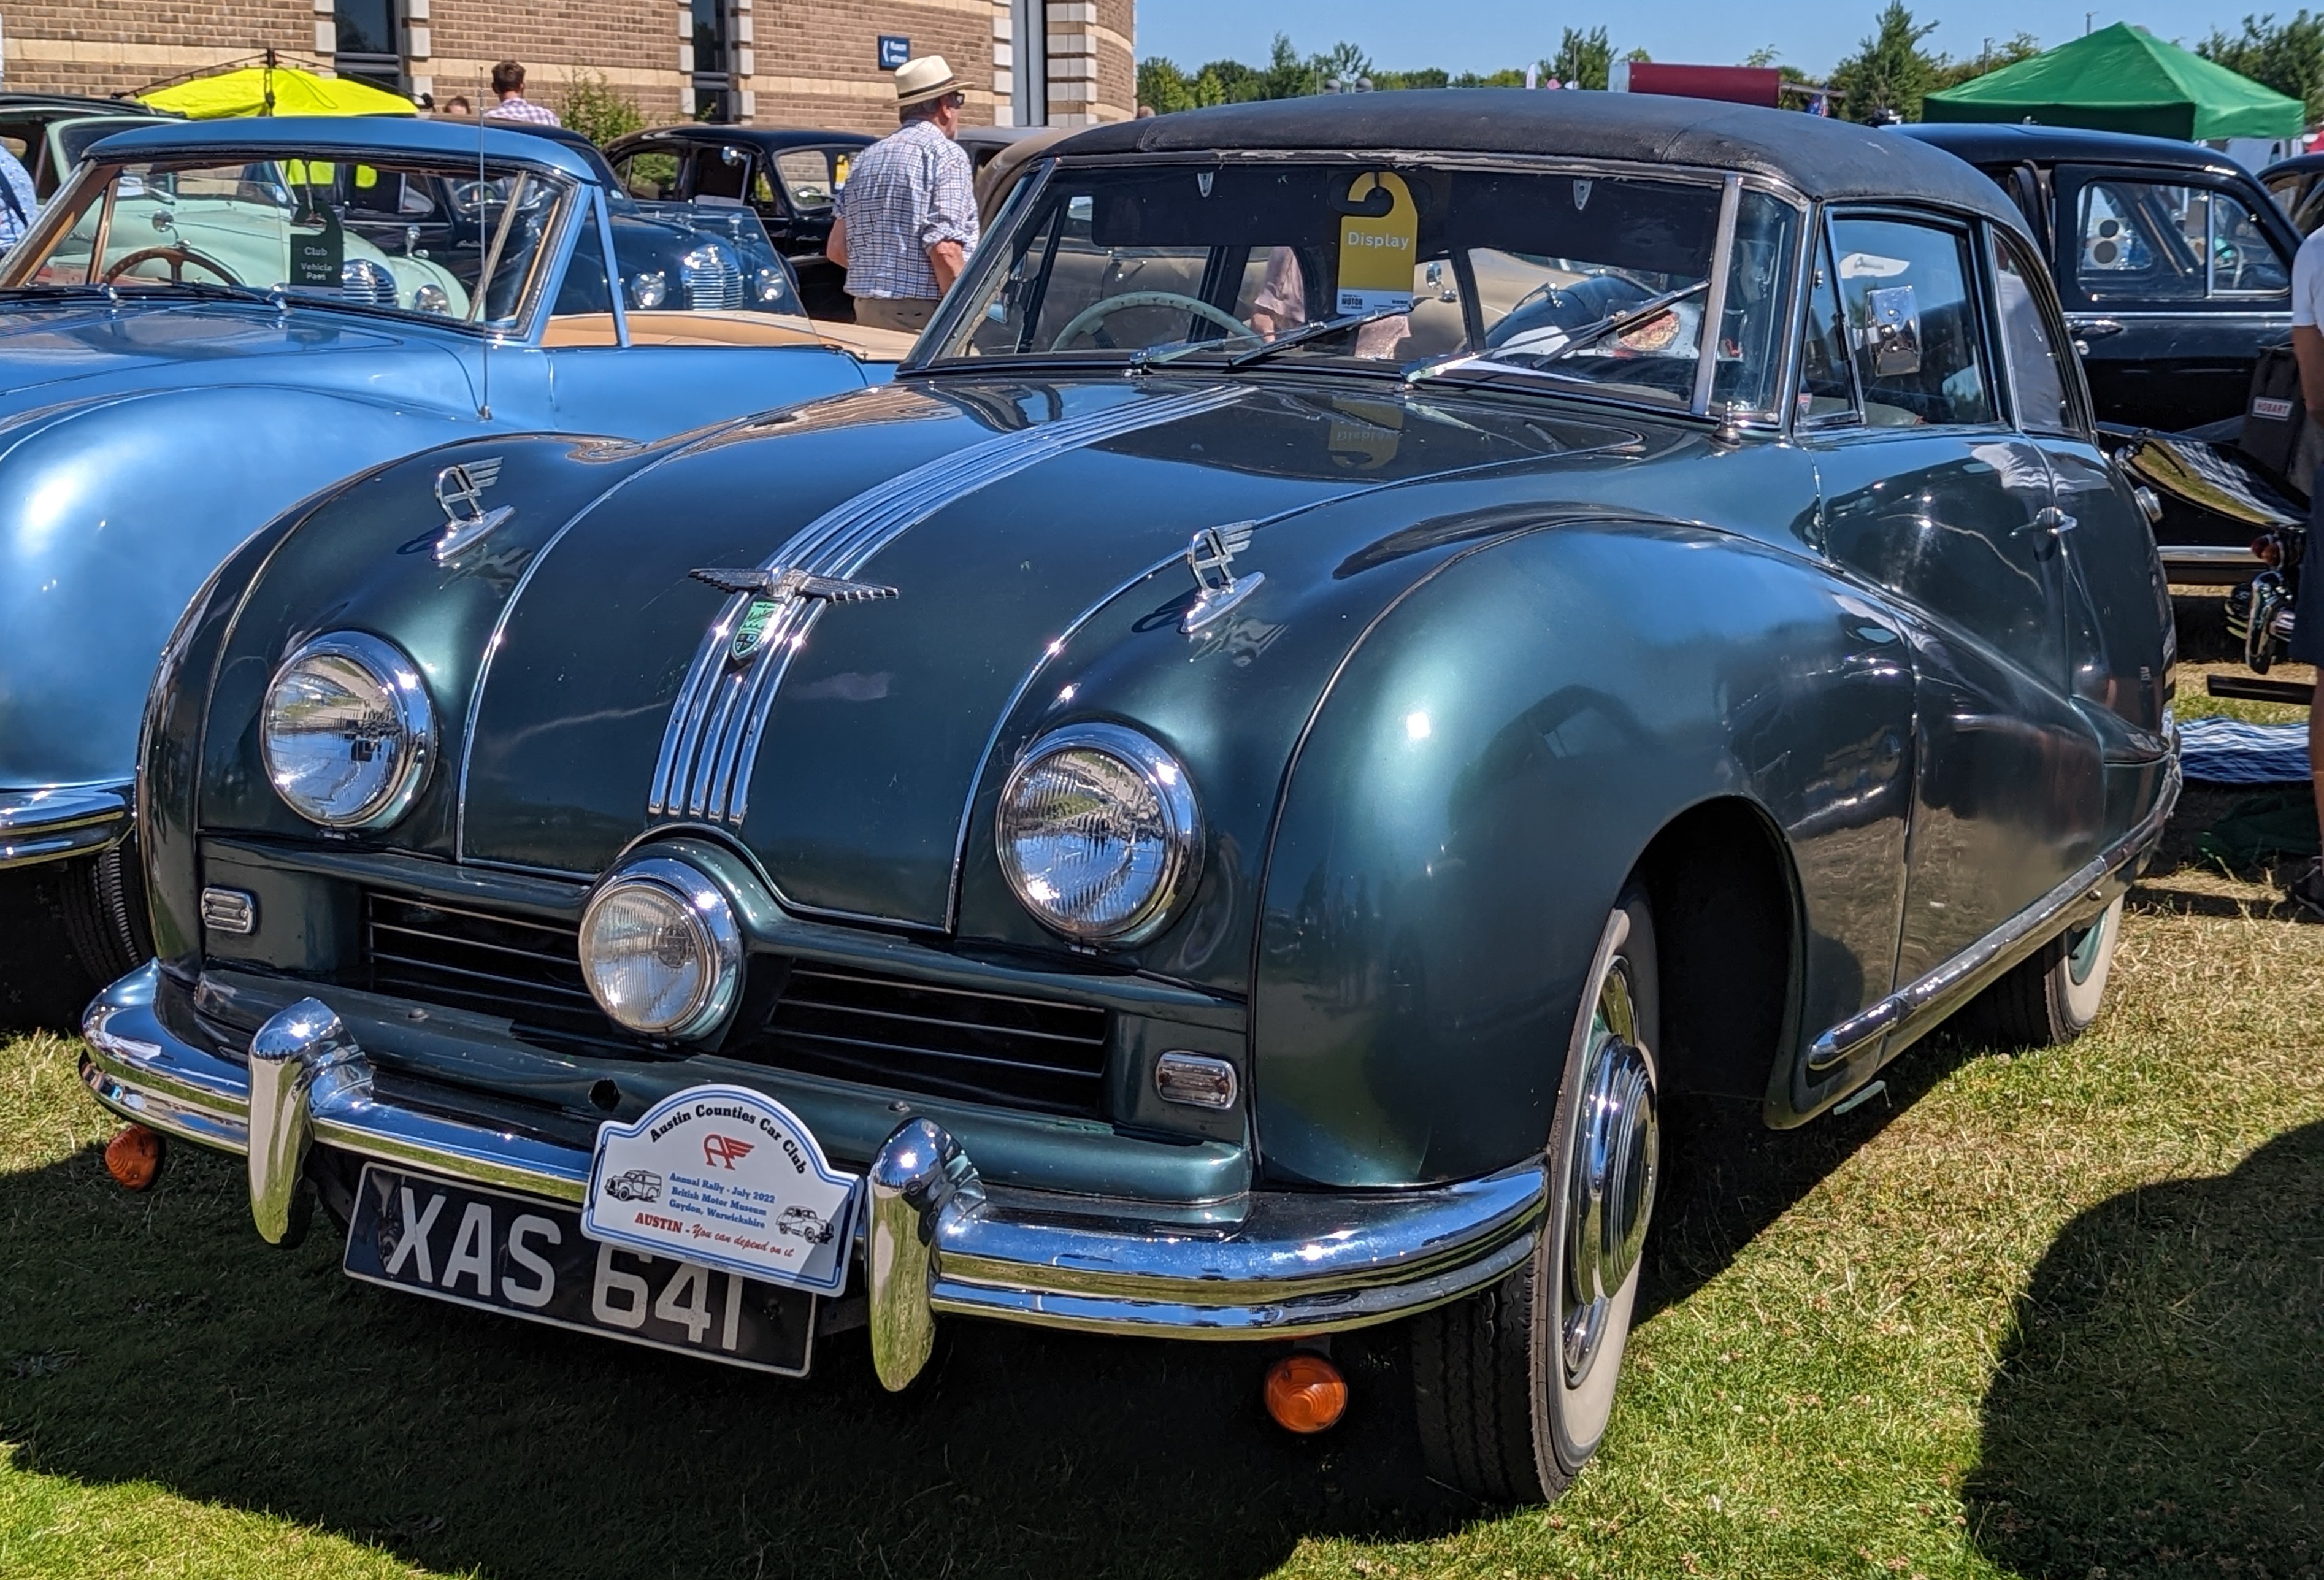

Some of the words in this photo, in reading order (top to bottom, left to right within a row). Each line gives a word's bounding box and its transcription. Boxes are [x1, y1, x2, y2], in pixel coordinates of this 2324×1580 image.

[304, 246, 328, 256] Club
[1347, 231, 1409, 250] Display
[301, 262, 333, 272] Vehicle
[306, 272, 326, 280] Pass
[650, 1112, 692, 1143] Austin
[695, 1104, 756, 1124] Counties
[759, 1118, 782, 1141] Car
[782, 1139, 807, 1175] Club
[669, 1172, 700, 1187] Annual
[702, 1179, 725, 1194] Rally
[732, 1186, 751, 1200] July
[753, 1191, 775, 1204] 2022
[671, 1186, 699, 1200] British
[701, 1193, 728, 1206] Motor
[729, 1200, 767, 1216] Museum
[669, 1199, 704, 1215] Gaydon,
[707, 1207, 765, 1229] Warwickshire
[634, 1211, 683, 1234] AUSTIN
[691, 1224, 713, 1239] You
[714, 1232, 732, 1243] can
[734, 1235, 770, 1252] depend
[769, 1245, 782, 1254] on
[784, 1248, 795, 1257] it
[386, 1187, 561, 1307] XAS
[592, 1243, 743, 1351] 641
